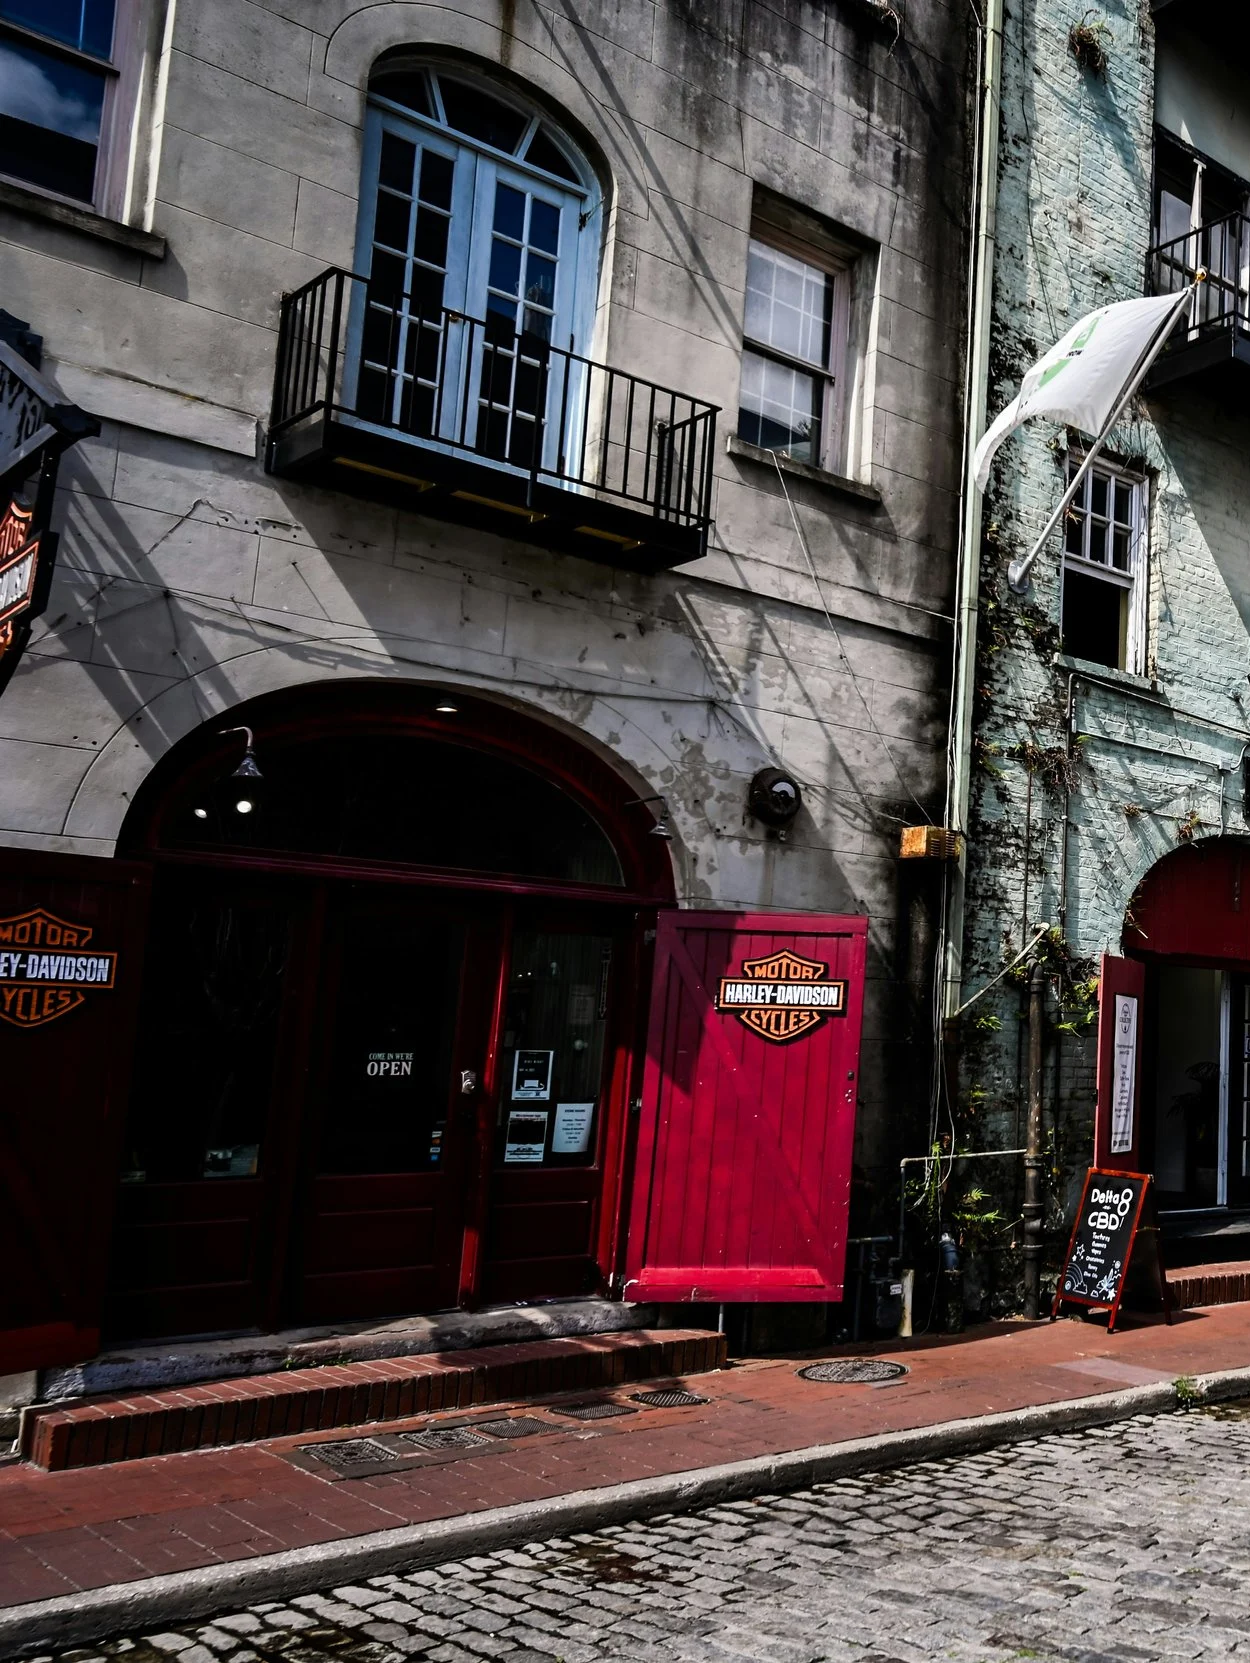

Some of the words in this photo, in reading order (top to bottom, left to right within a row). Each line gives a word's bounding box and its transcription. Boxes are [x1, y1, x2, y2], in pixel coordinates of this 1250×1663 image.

[754, 957, 814, 979] MOTOR
[725, 983, 839, 1006] HARLEY-DAVIDSON
[750, 1010, 811, 1035] CYCLES
[368, 1052, 386, 1061] COME
[387, 1052, 394, 1061] IN
[366, 1061, 413, 1076] OPEN
[1091, 1188, 1120, 1205] Delta
[1116, 1188, 1133, 1217] 8
